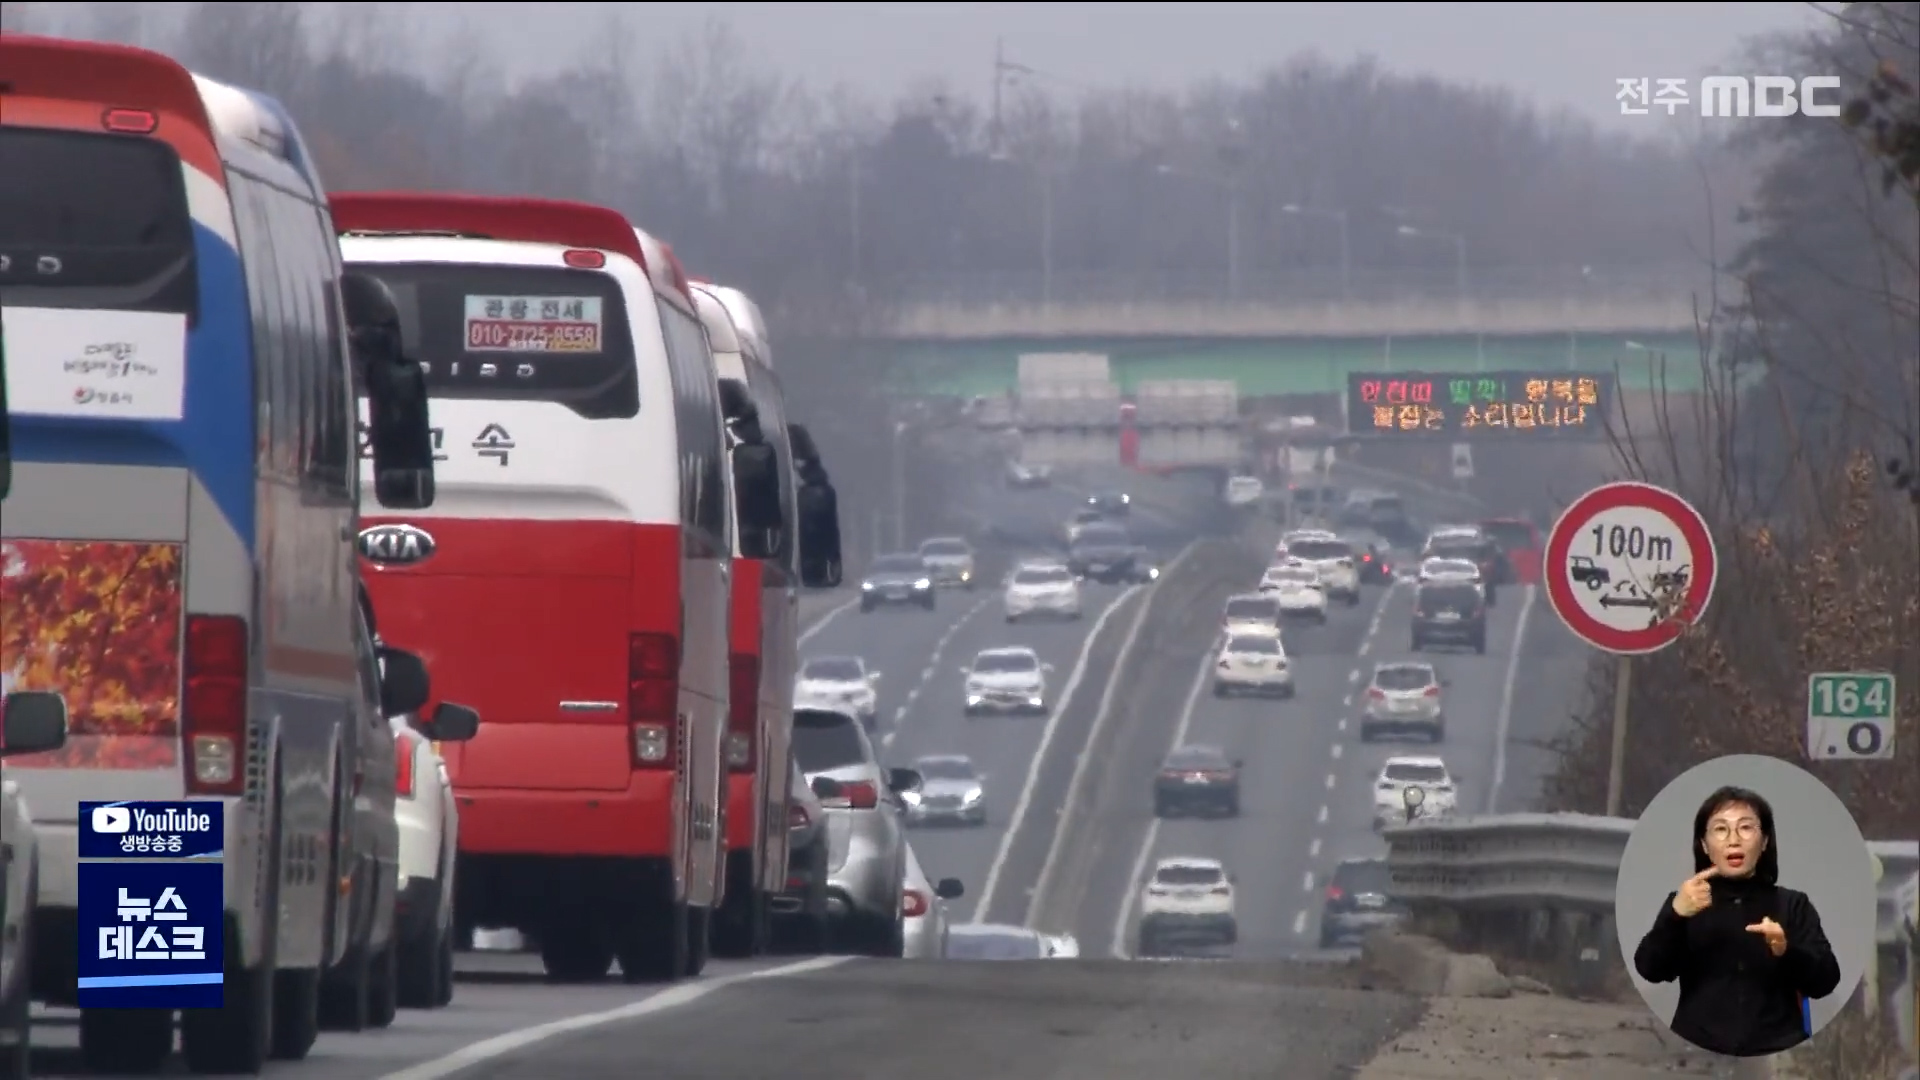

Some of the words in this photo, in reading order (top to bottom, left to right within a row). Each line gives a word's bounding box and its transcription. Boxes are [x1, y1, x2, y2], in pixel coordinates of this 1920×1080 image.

[540, 299, 585, 321] 전세
[1461, 402, 1587, 430] 소리입니다
[365, 532, 423, 558] KIA
[1592, 523, 1673, 562] 100m
[1815, 679, 1887, 715] 164
